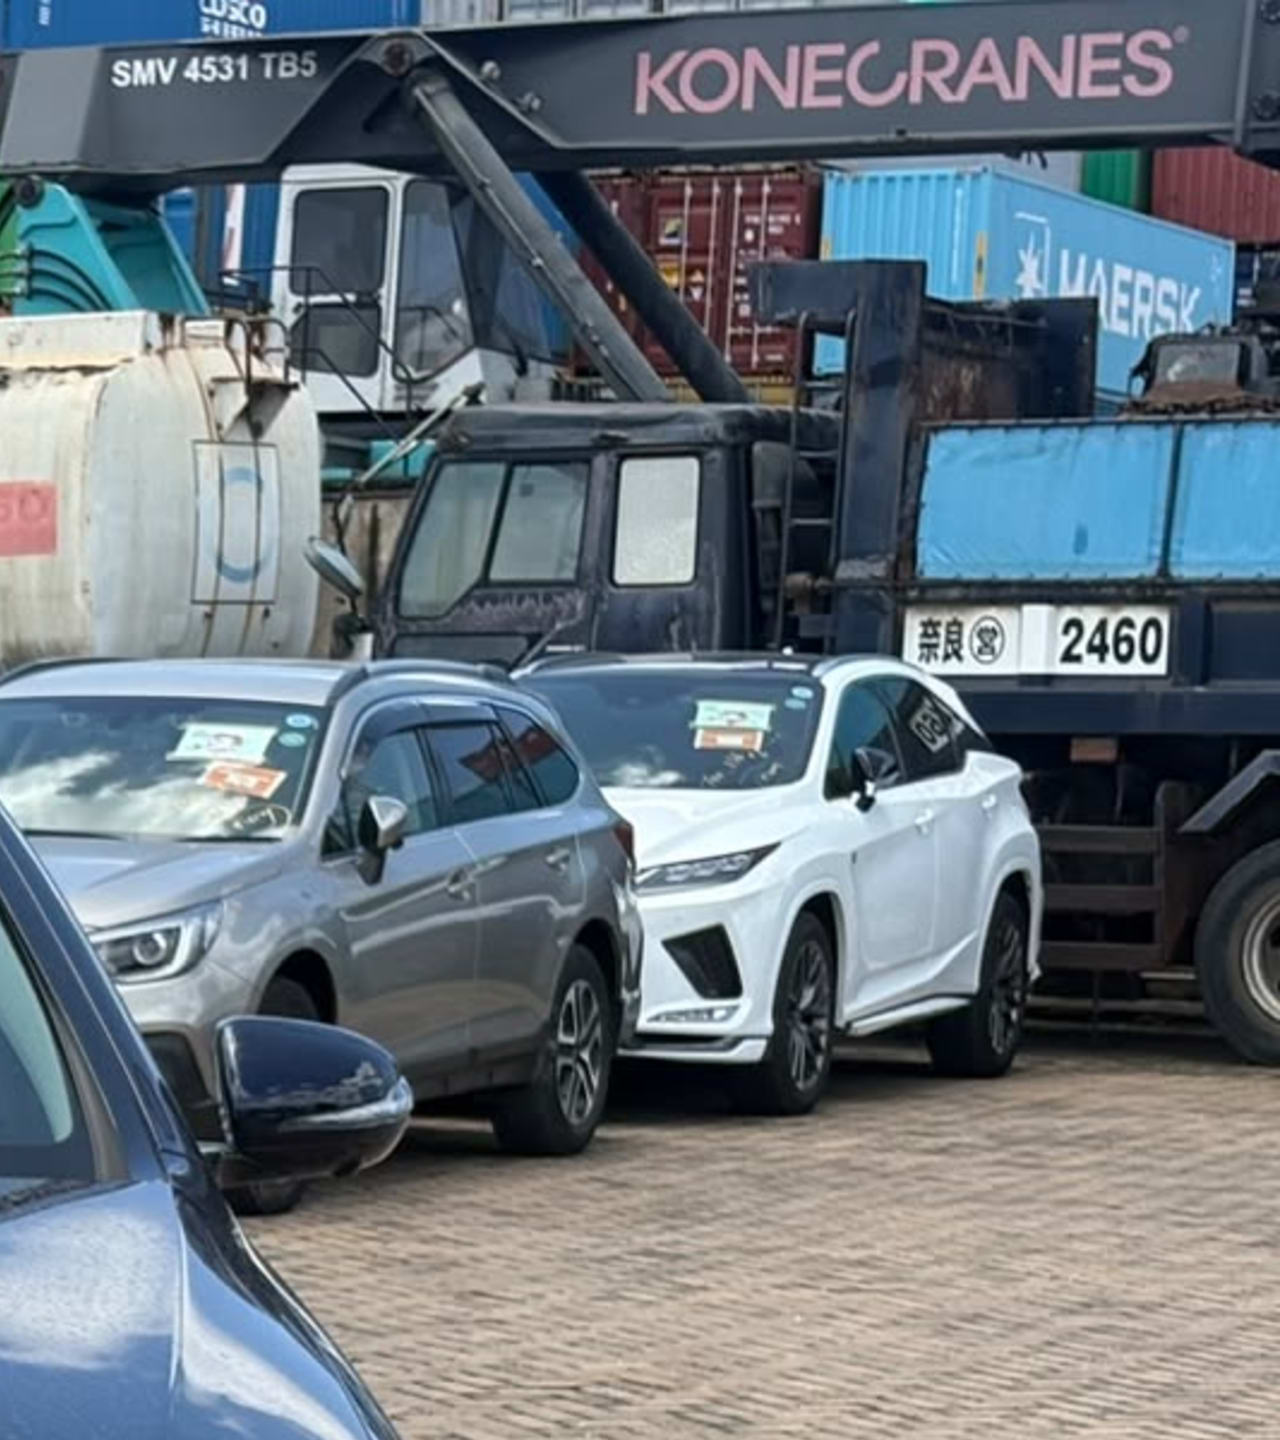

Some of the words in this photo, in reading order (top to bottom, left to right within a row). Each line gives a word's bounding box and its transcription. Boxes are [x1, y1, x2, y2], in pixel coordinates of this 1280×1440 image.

[110, 57, 177, 88] SMV
[183, 54, 249, 83] 4531
[259, 50, 318, 80] TB5
[635, 27, 1173, 115] KONECRANES
[1057, 248, 1202, 341] MAERSK
[1059, 616, 1164, 665] 2460
